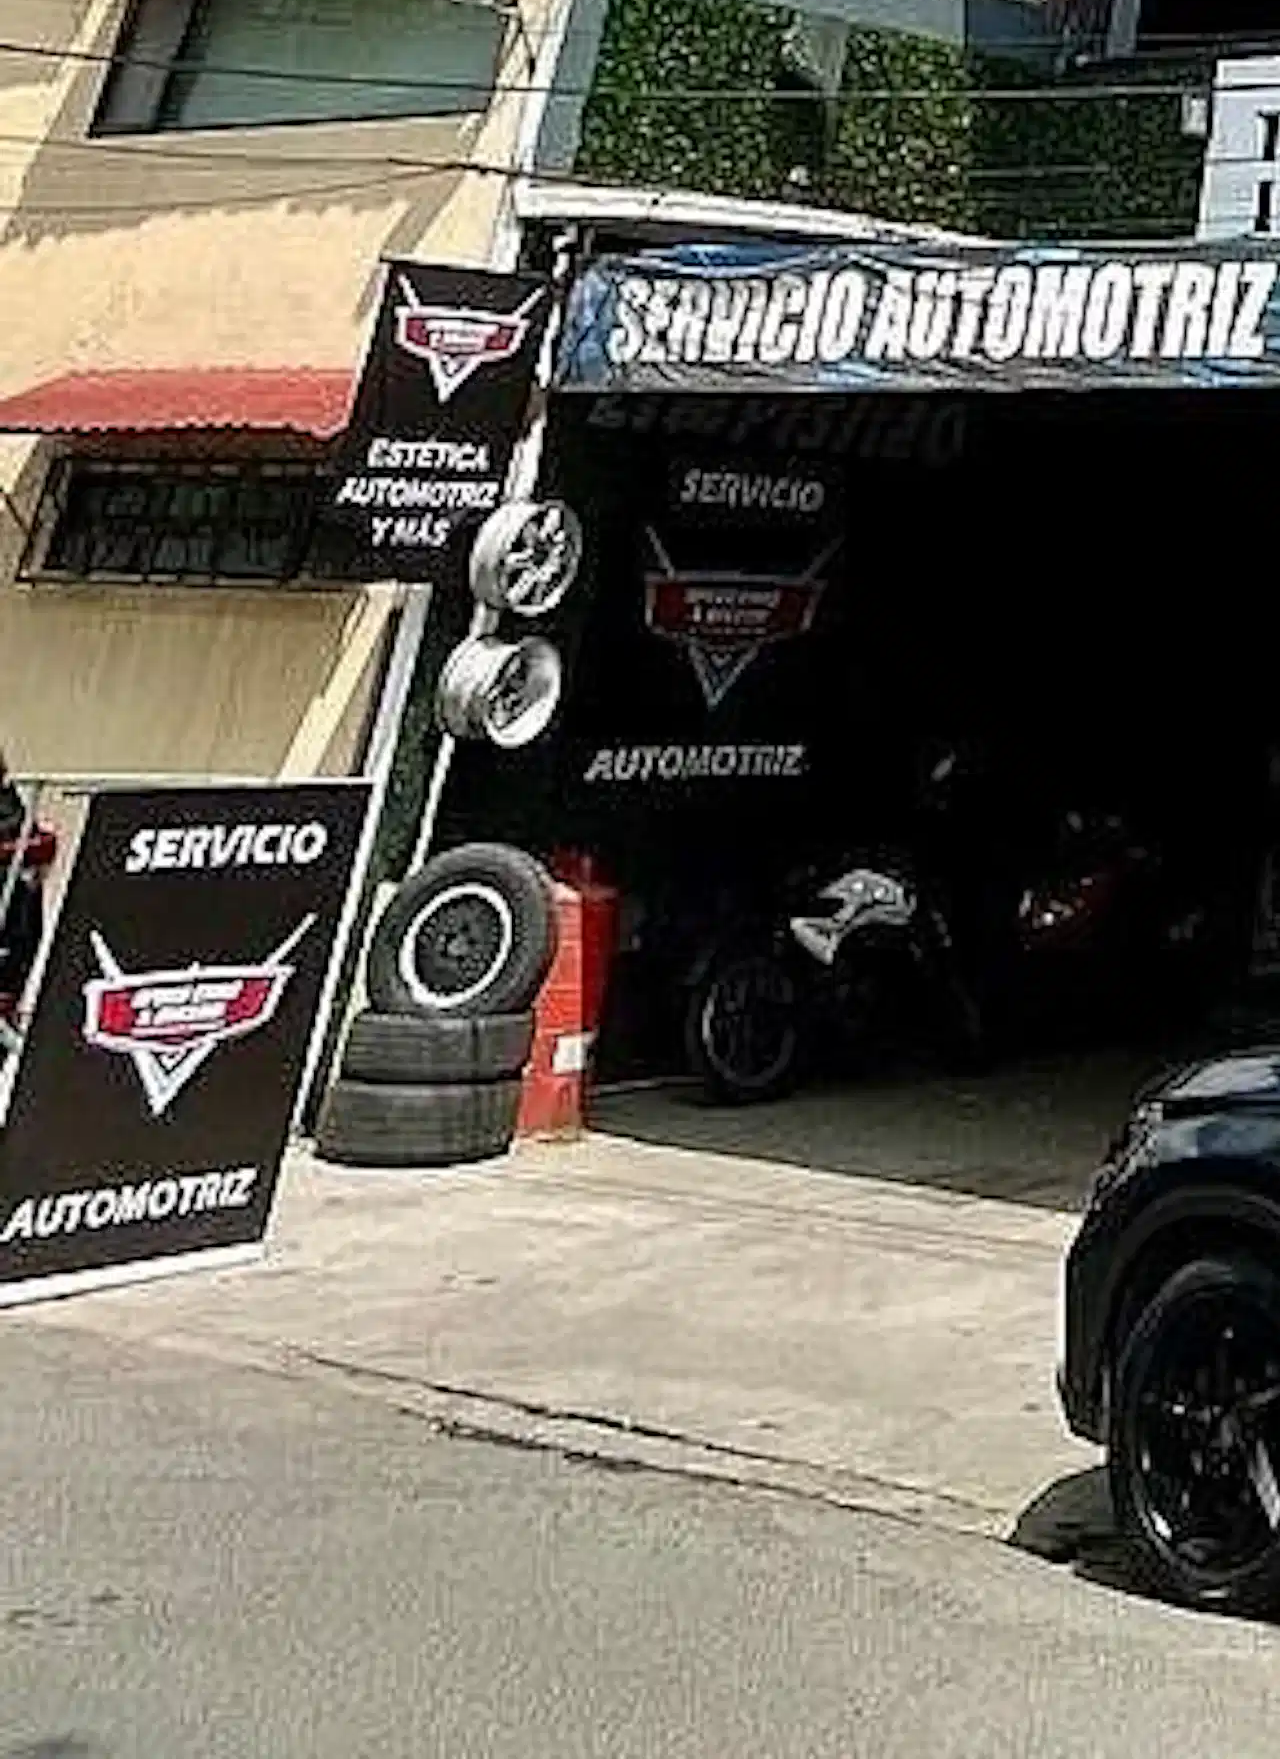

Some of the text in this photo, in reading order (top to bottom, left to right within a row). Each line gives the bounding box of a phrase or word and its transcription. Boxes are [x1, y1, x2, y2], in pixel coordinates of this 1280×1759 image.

[606, 264, 868, 365] SERVICIO
[863, 260, 1278, 360] AUTOMOTRIZ
[336, 476, 499, 509] AUTOMOTRIZ
[680, 467, 825, 512] SERVICIO
[584, 744, 806, 782] AUTOMOTRIZ
[126, 821, 329, 873] SERVICIO
[0, 1167, 258, 1243] AUTOMOTRIZ
